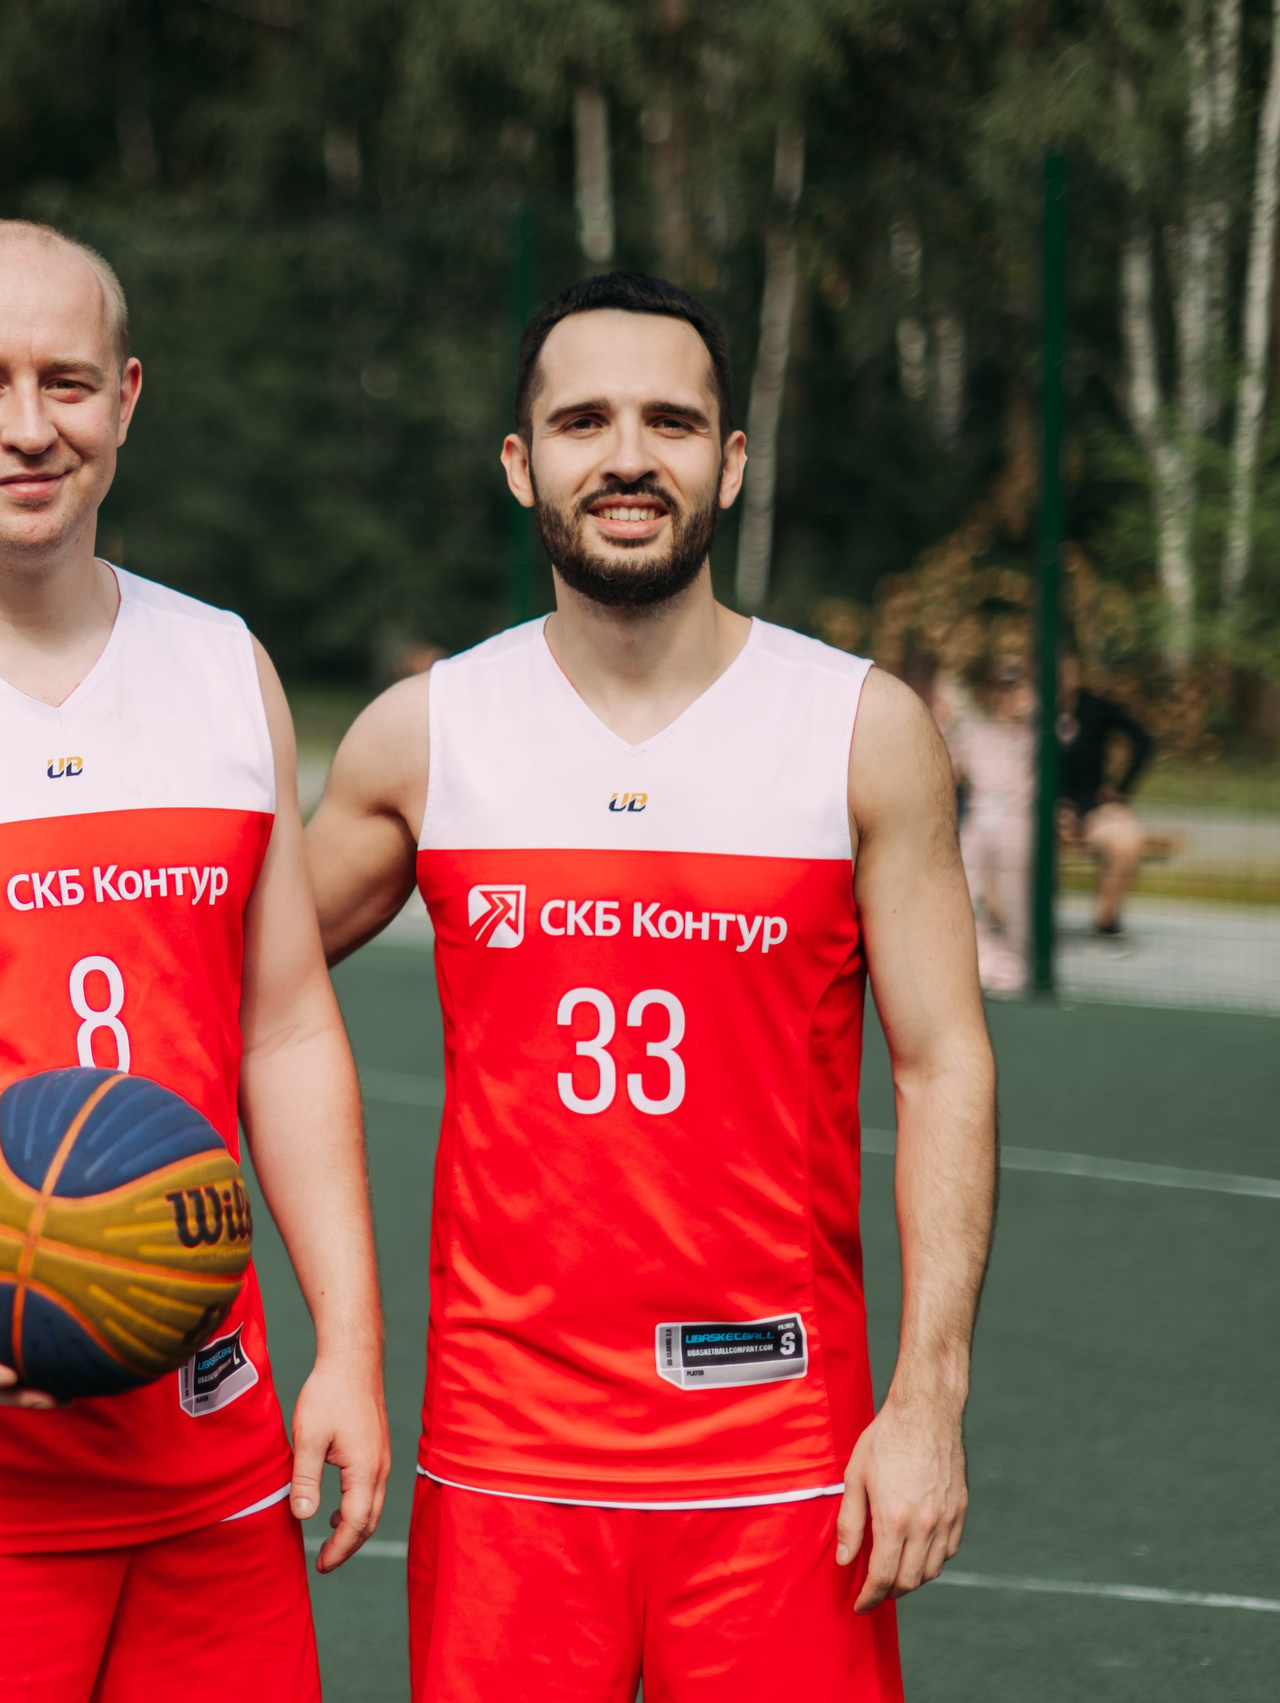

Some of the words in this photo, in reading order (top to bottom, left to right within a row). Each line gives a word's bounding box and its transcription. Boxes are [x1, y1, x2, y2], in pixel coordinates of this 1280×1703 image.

[47, 756, 83, 779] UB
[608, 792, 648, 812] UB
[6, 868, 85, 911] СКБ
[92, 864, 229, 906] Контур
[539, 899, 621, 937] СКБ
[632, 901, 788, 954] Контур
[69, 955, 131, 1074] 8
[556, 987, 686, 1116] 33
[685, 1331, 775, 1344] UBASKETBALL
[780, 1331, 796, 1356] S
[687, 1344, 773, 1357] UBASKETBALLCOMPANY.COM
